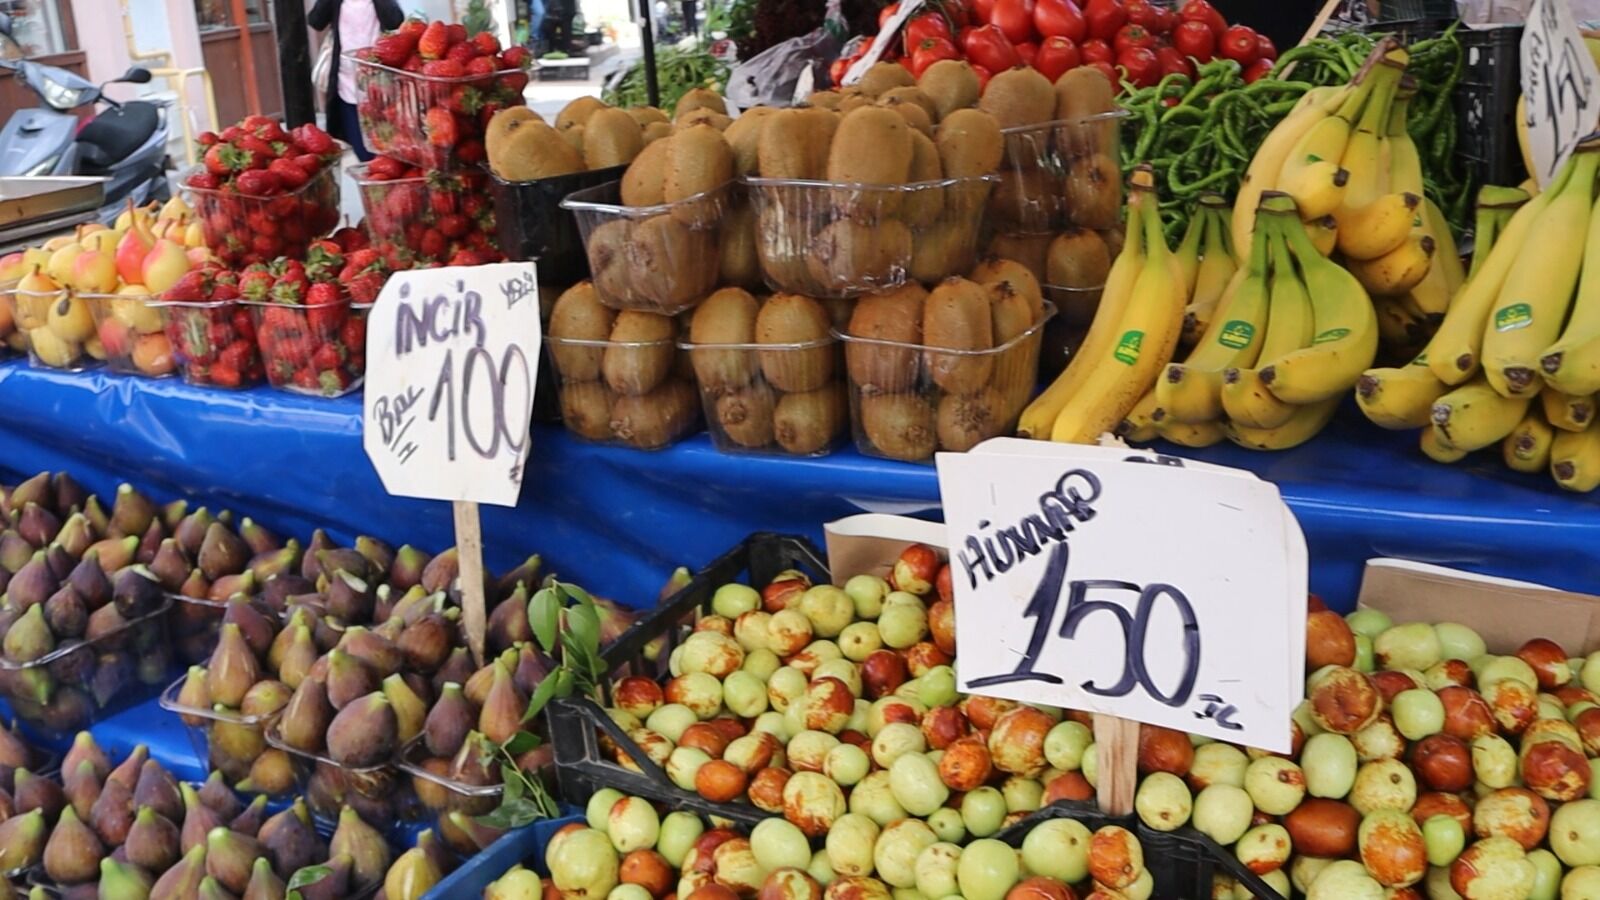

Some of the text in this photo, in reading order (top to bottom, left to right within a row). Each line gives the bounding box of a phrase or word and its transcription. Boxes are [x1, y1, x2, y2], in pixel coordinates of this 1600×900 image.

[395, 280, 486, 356] İNCİR
[429, 343, 531, 461] 100
[965, 541, 1201, 708] 150
